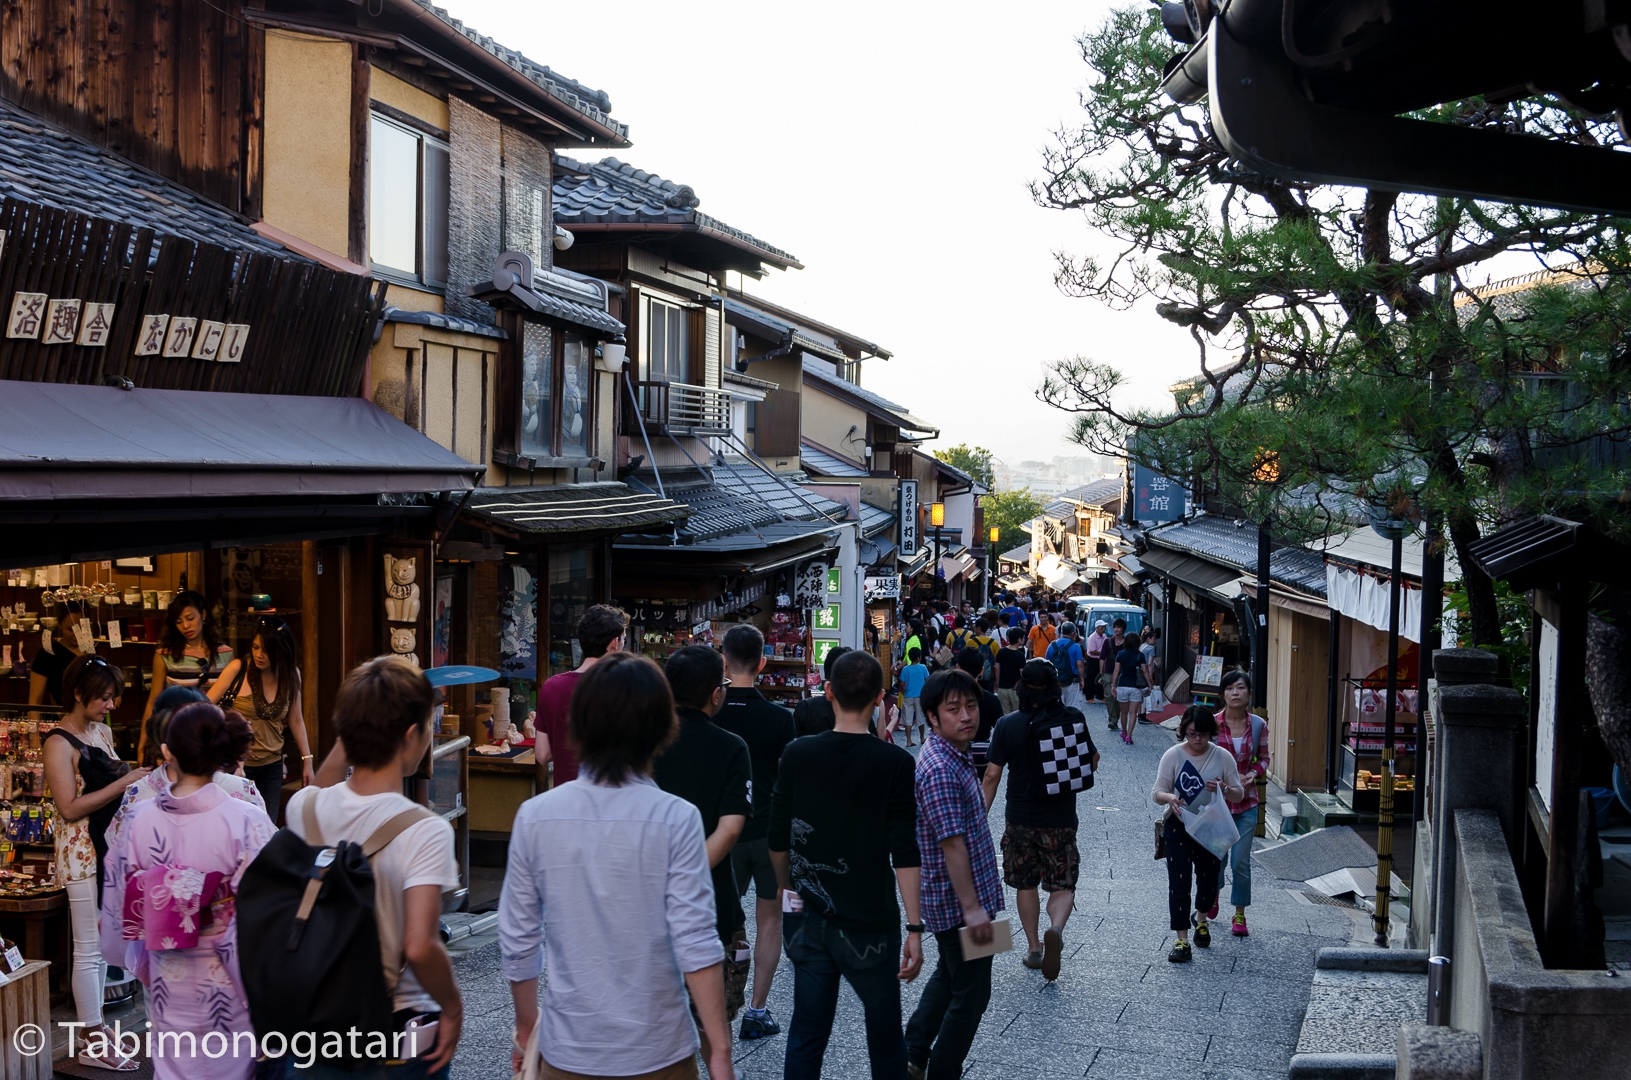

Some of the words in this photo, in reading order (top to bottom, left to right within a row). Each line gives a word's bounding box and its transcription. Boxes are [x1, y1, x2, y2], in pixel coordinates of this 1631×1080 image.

[143, 316, 241, 358] なかにし
[903, 526, 914, 551] 打田
[809, 564, 824, 609] 西陣織
[874, 577, 899, 592] 果実
